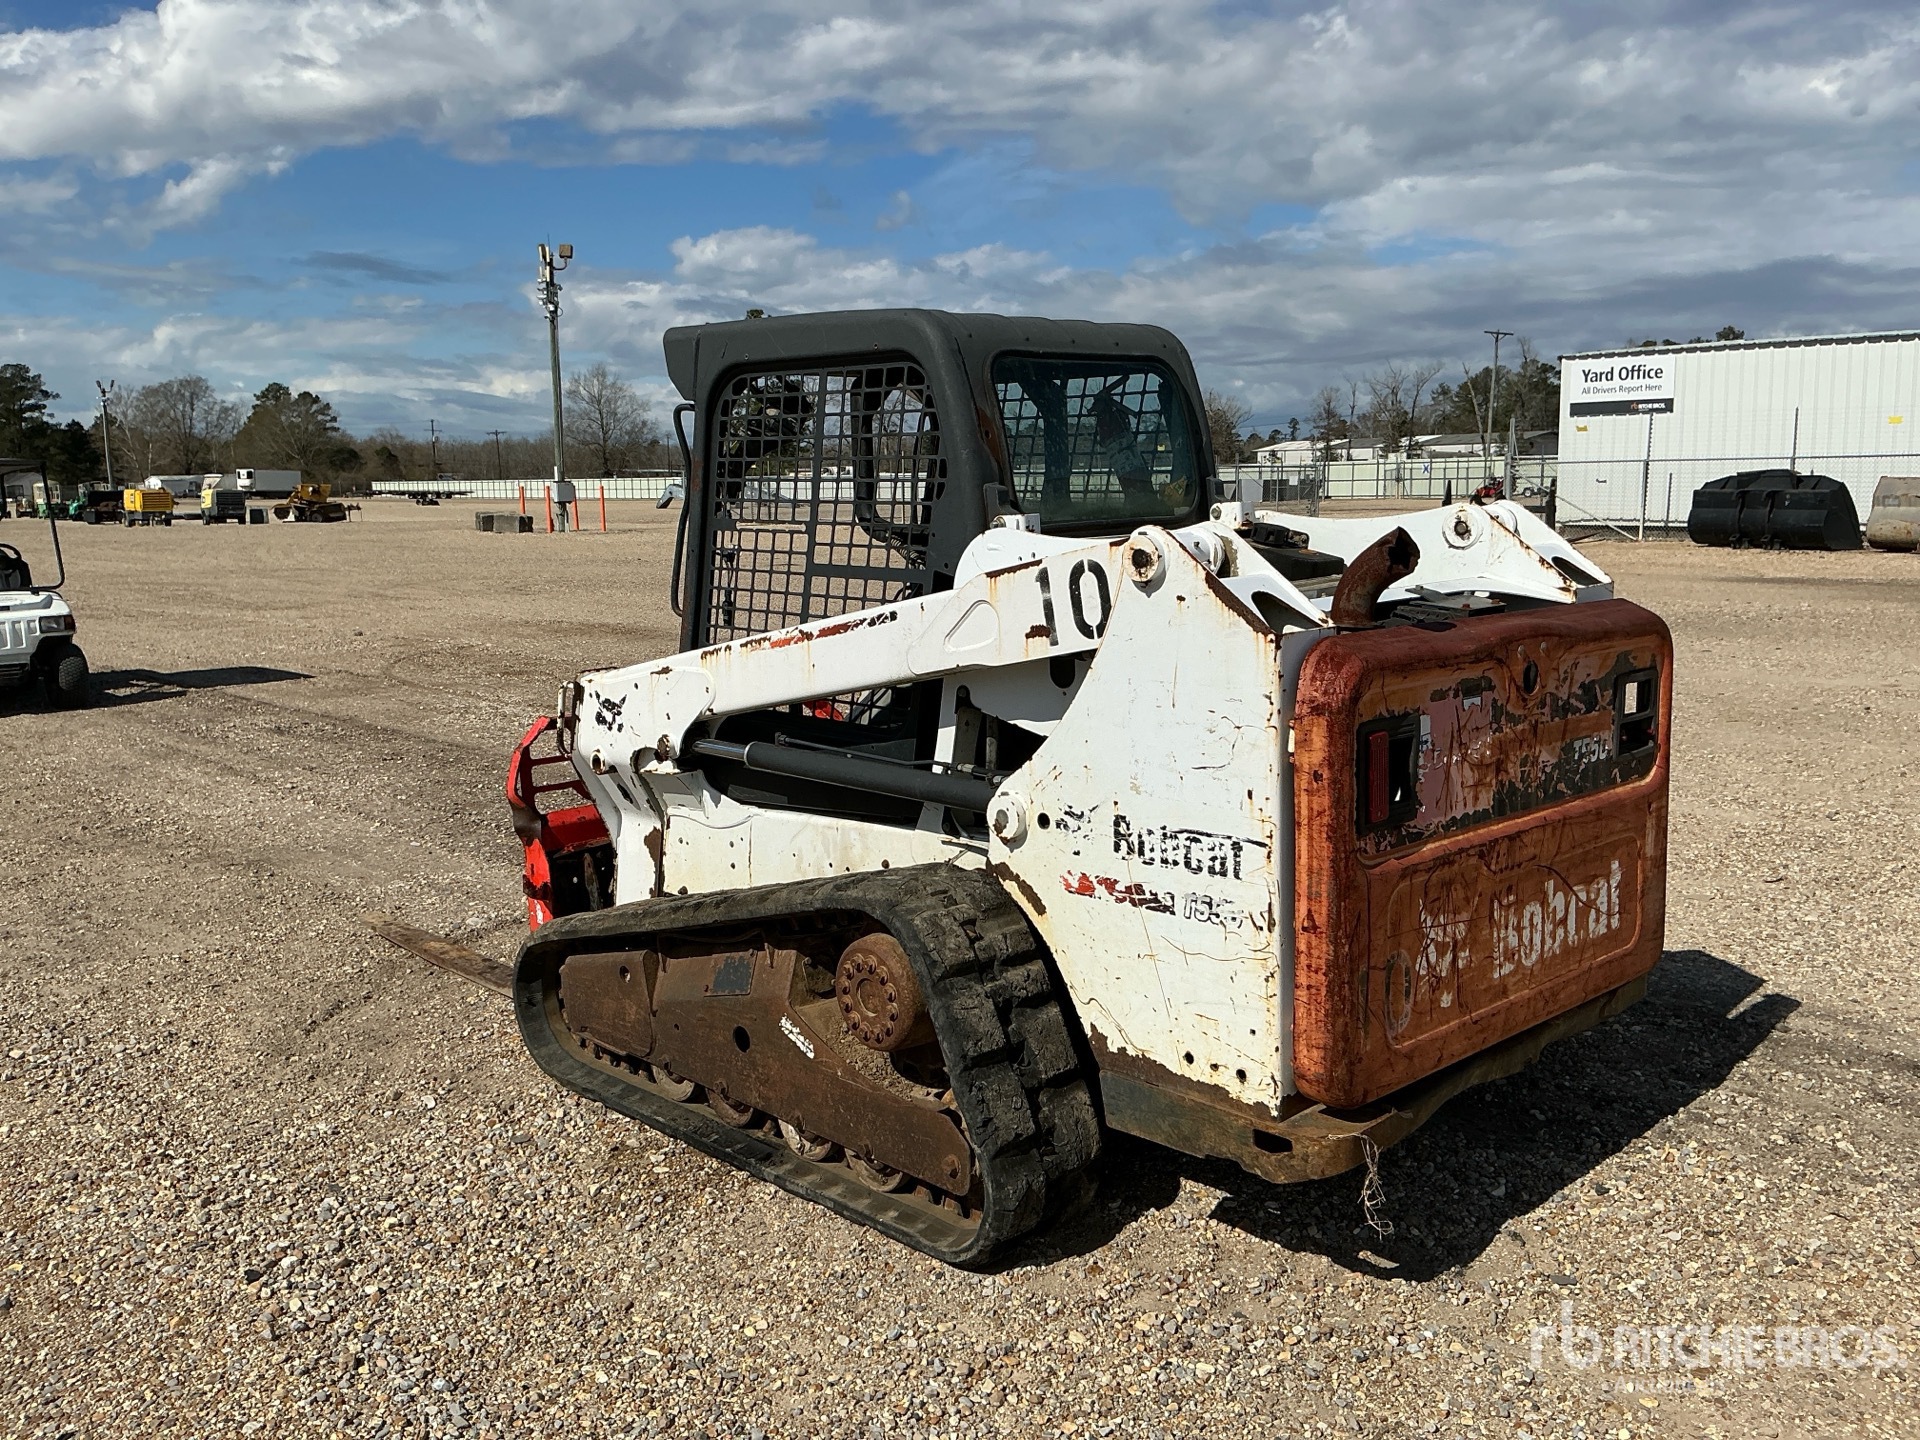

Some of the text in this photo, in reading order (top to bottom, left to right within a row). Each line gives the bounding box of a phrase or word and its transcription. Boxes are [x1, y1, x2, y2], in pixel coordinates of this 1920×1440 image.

[1582, 364, 1664, 383] Yard Office
[1581, 383, 1662, 395] All Drivers Report Here
[1035, 559, 1112, 647] 10
